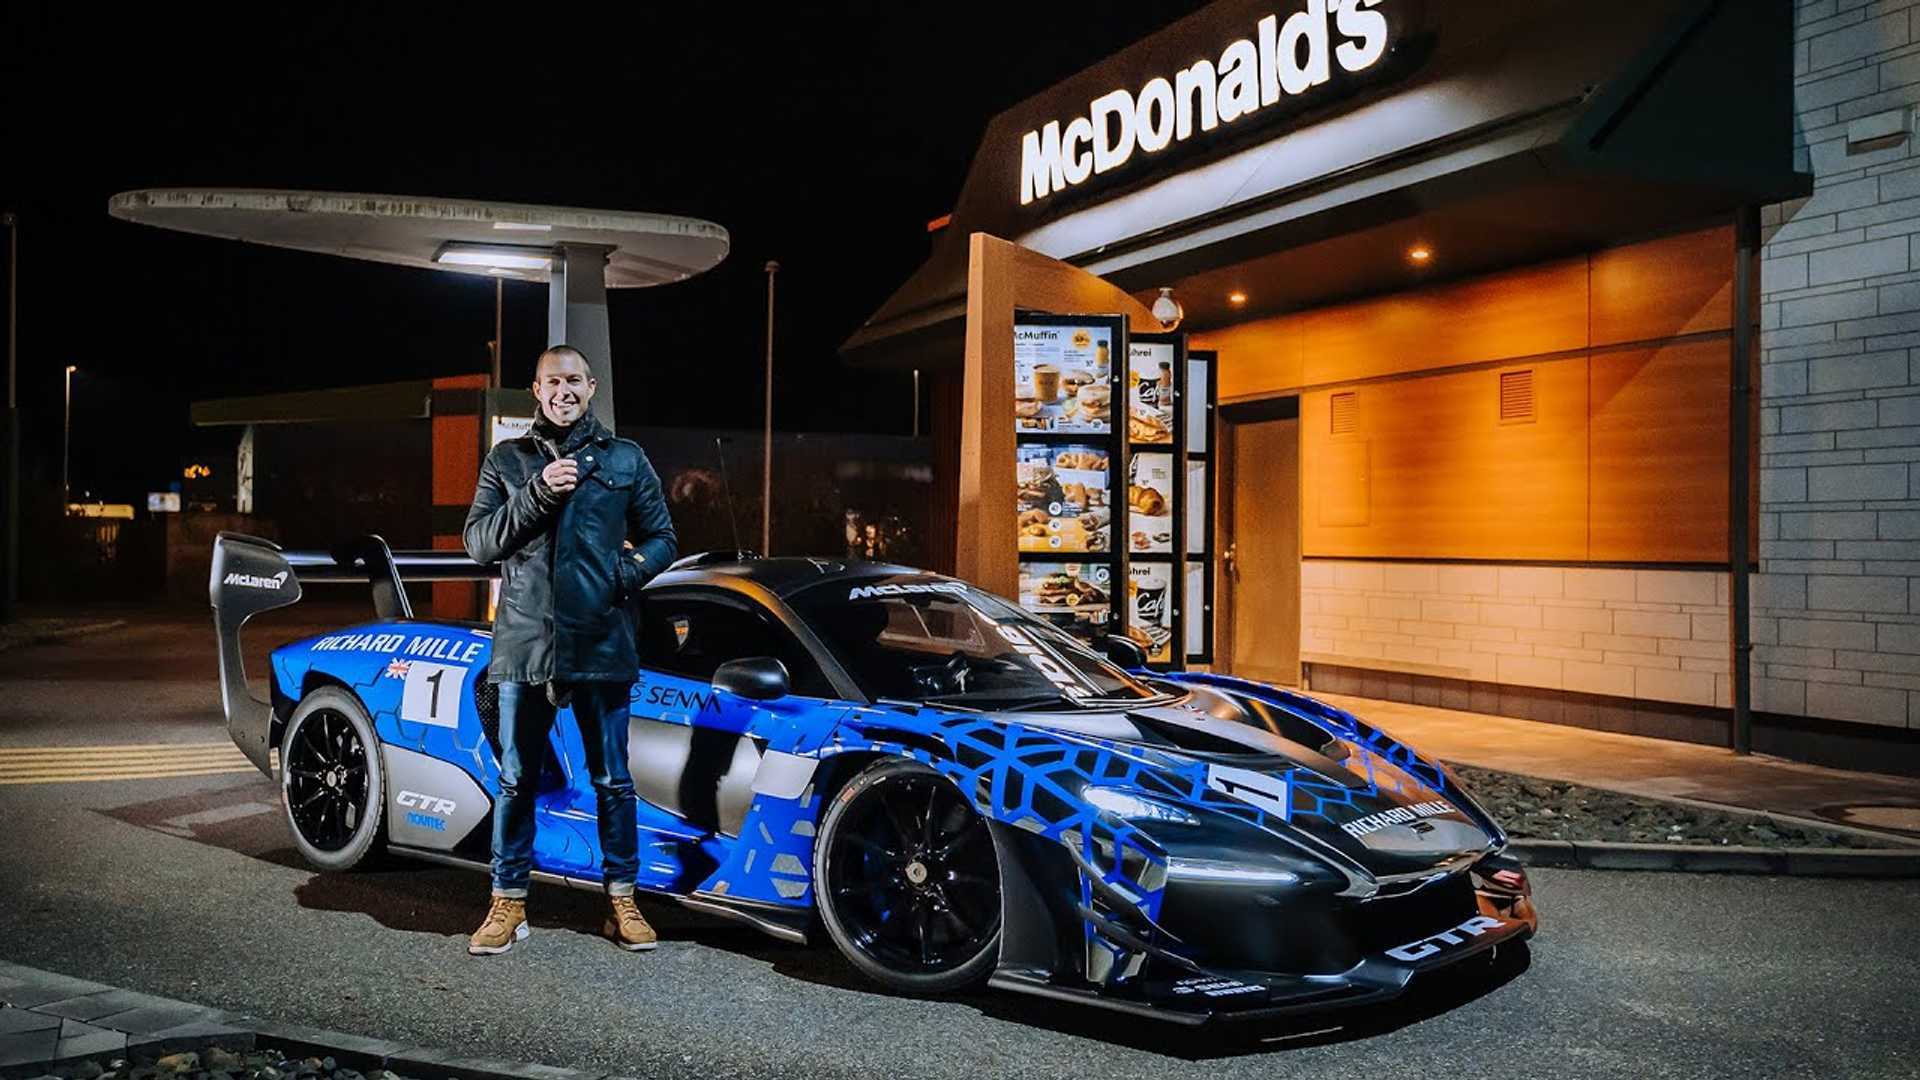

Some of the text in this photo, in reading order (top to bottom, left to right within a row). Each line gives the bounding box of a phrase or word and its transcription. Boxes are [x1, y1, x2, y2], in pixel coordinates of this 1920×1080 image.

[223, 573, 281, 590] McLaren
[311, 634, 485, 663] RICHARD MILLE
[426, 668, 444, 719] 1
[645, 686, 723, 715] SENNA
[396, 790, 457, 816] GTR
[1341, 800, 1457, 838] RICHARD MILLE
[1385, 915, 1506, 961] GTR
